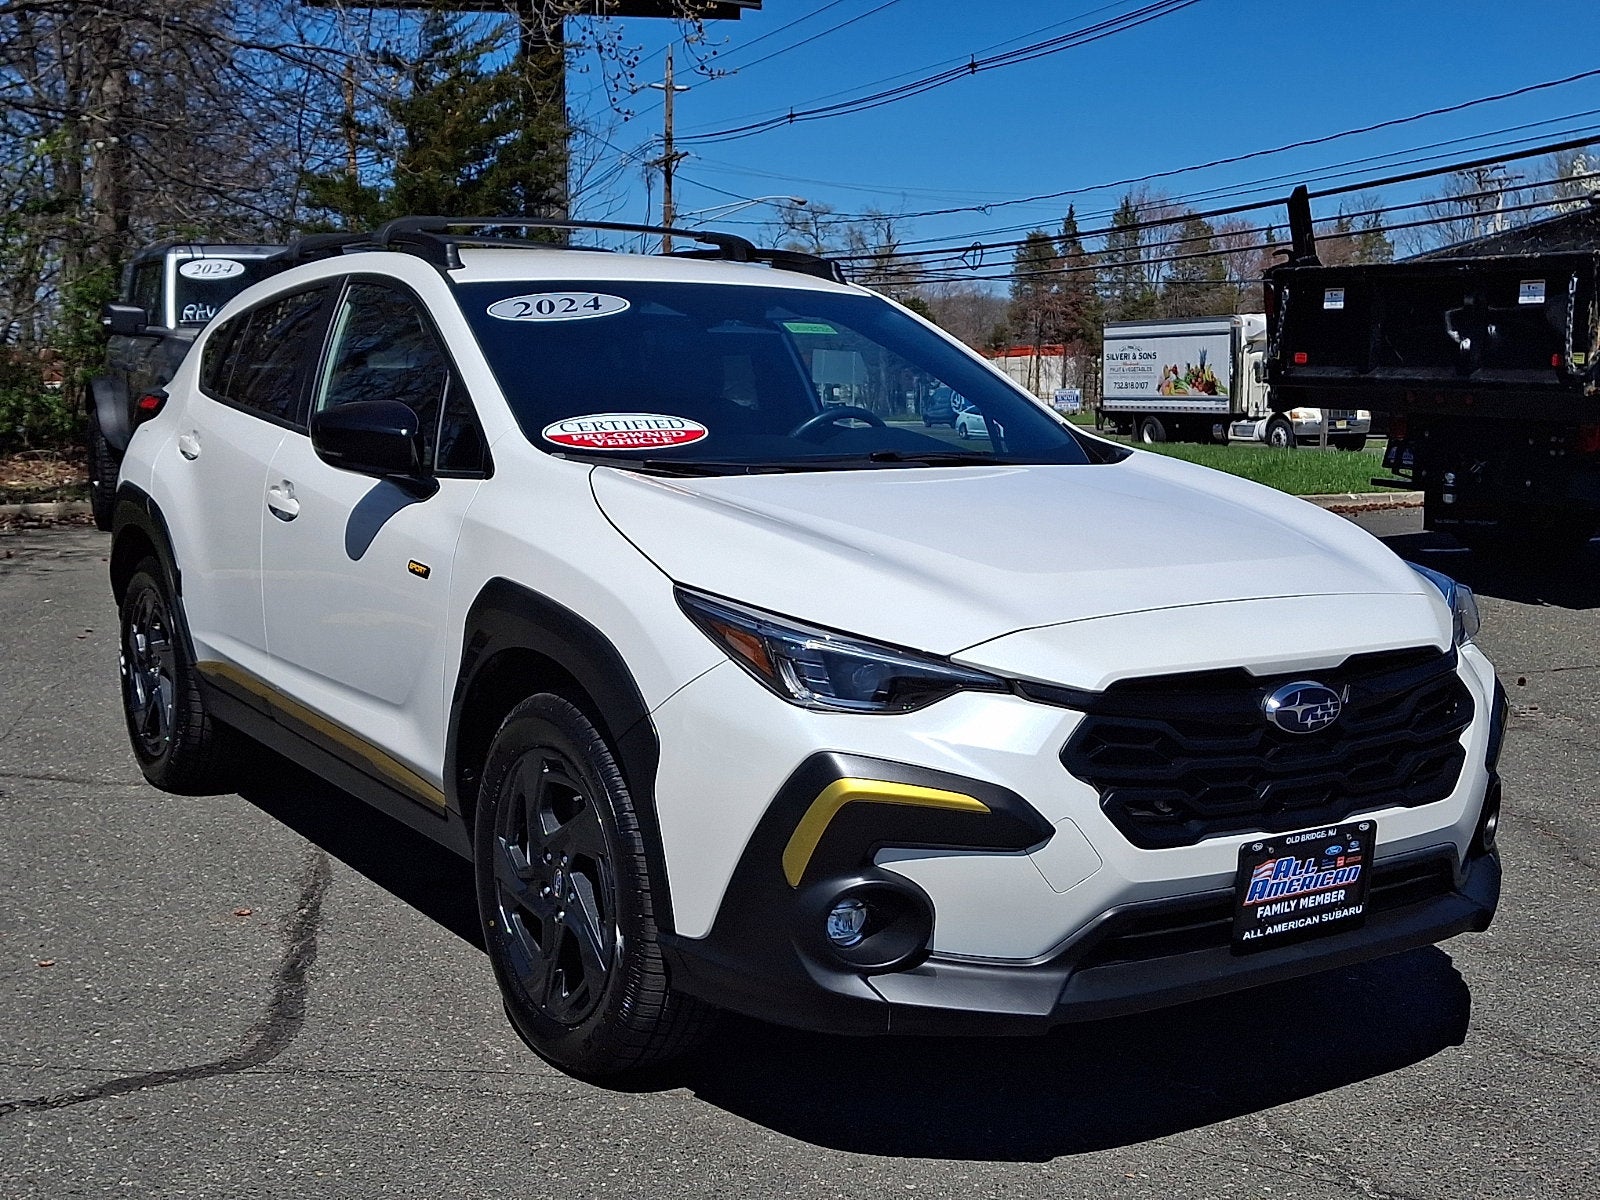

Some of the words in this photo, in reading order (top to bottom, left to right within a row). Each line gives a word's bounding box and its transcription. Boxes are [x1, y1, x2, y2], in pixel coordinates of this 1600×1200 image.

[192, 264, 234, 275] 2024
[513, 296, 602, 318] 2024
[1106, 353, 1130, 361] SILVERI
[1132, 352, 1137, 360] &
[1138, 351, 1157, 360] SONS
[1113, 381, 1149, 389] 732.818.0107
[560, 419, 685, 433] CERTIFIED
[571, 430, 687, 441] PRE-OWNED
[591, 436, 675, 446] VEHICLE
[409, 562, 427, 574] SPORT
[1286, 835, 1300, 844] OLD
[1328, 828, 1337, 836] NJ
[1245, 865, 1361, 903] AMERICAN
[1257, 899, 1298, 919] FAMILY
[1299, 889, 1346, 909] MEMBER
[1242, 928, 1264, 941] ALL
[1265, 915, 1320, 936] AMERICAN
[1321, 904, 1363, 922] SUBARU
